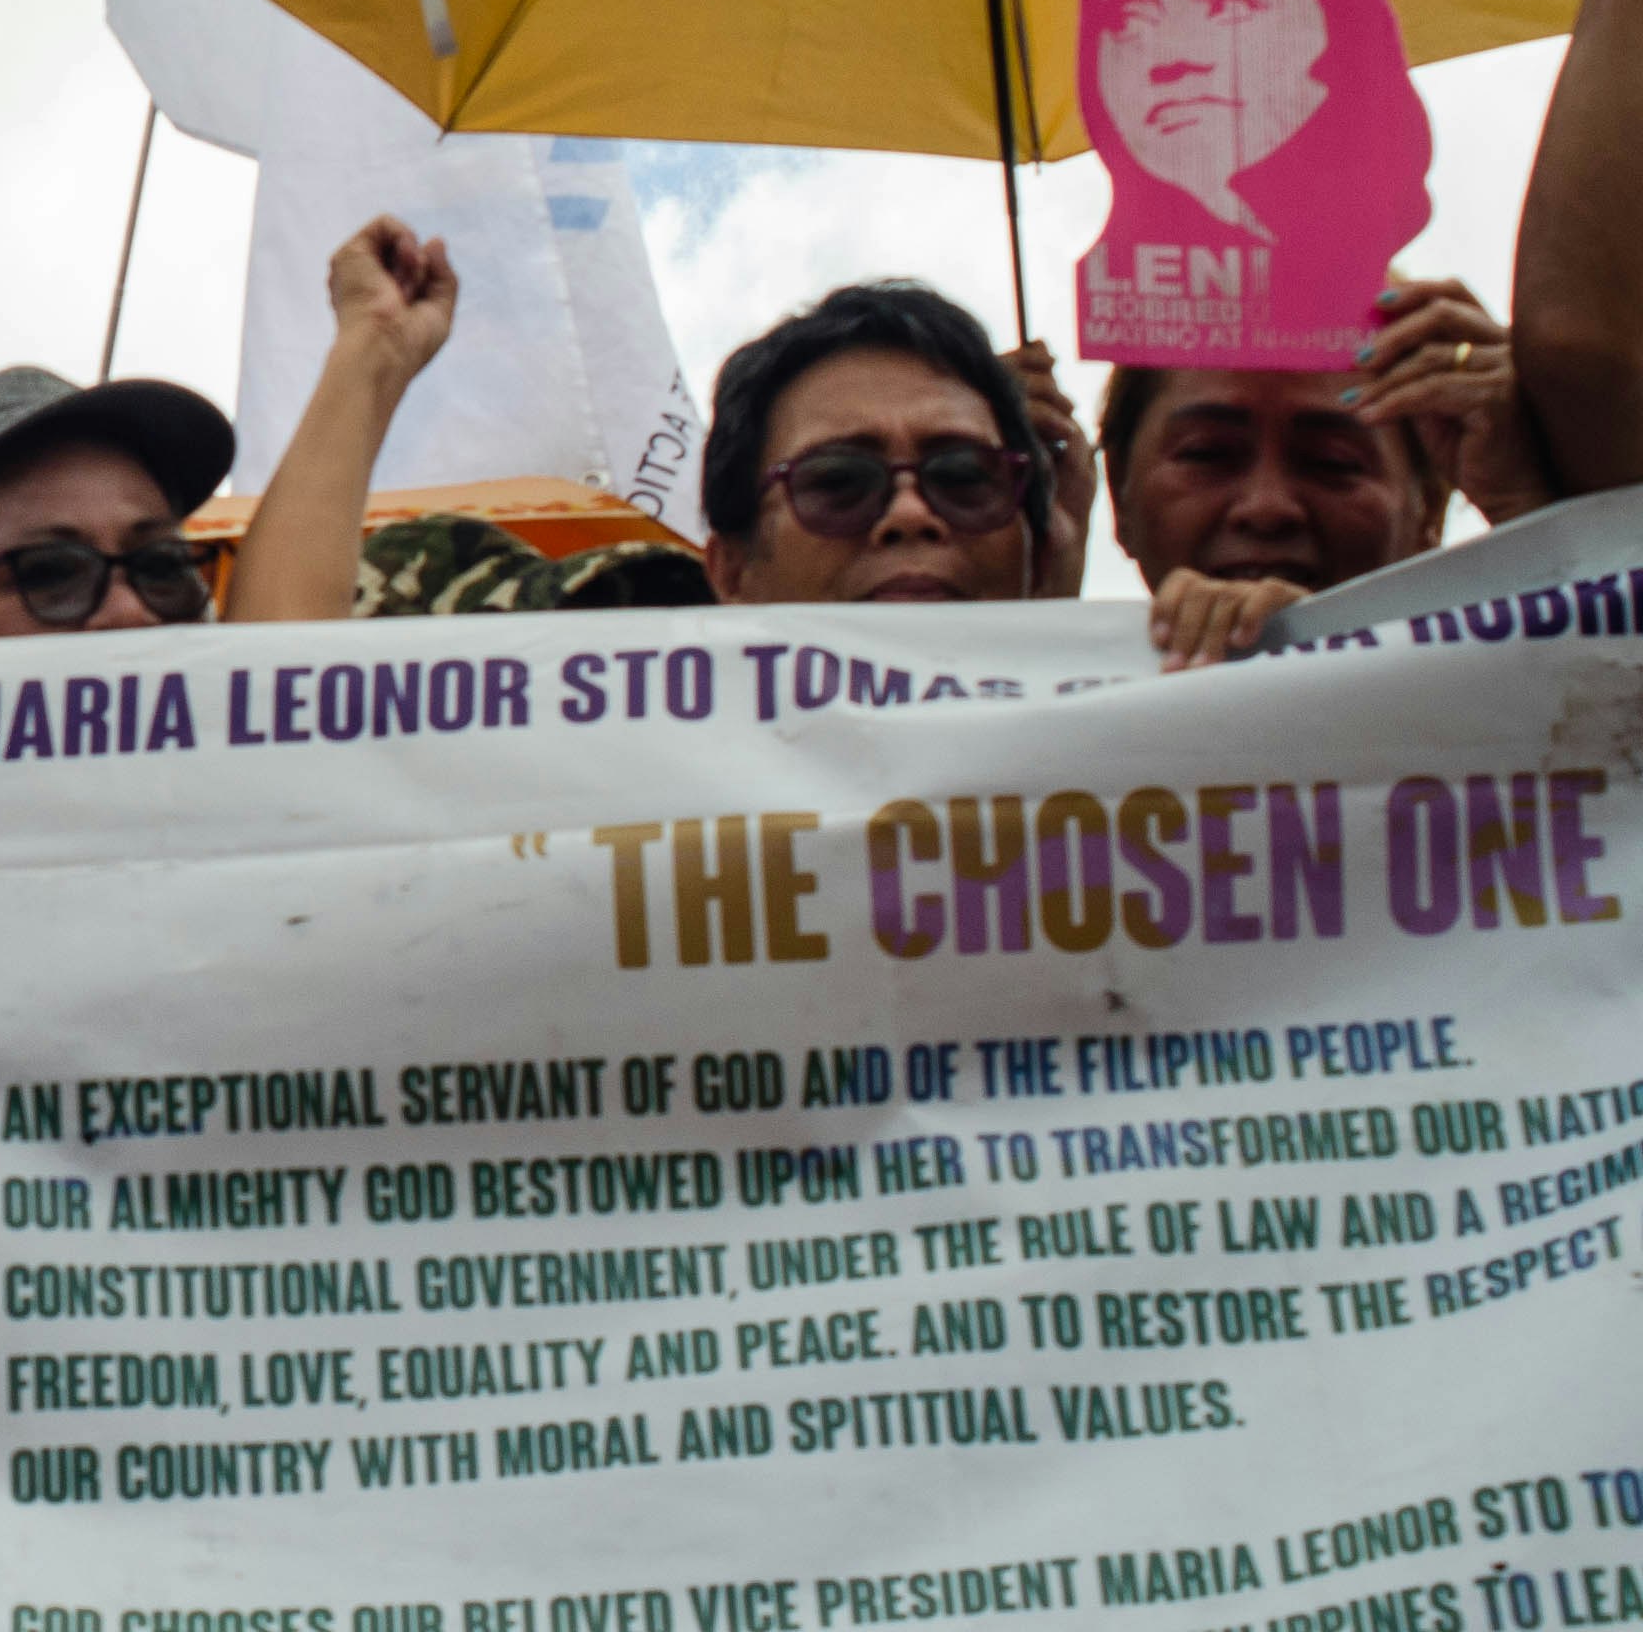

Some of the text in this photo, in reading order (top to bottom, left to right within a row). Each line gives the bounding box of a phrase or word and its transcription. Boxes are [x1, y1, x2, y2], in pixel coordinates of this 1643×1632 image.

[1085, 244, 1272, 296] LENI
[227, 657, 530, 746] LEONOR
[560, 646, 714, 724] STO
[593, 811, 830, 970] THE
[867, 781, 1345, 960] CHOSEN
[1386, 770, 1622, 938] ONE
[2, 1016, 1476, 1141] AN EXCEPTIONAL SERVANT OF GOD AND OF THE FILIPINO PEOPLE.
[3, 1177, 92, 1231] OUR
[109, 1168, 347, 1232] ALMIGHTY
[366, 1161, 455, 1223] GOD
[473, 1152, 722, 1219] BESTOWED
[737, 1145, 860, 1208] UPON
[874, 1135, 965, 1195] HER
[979, 1132, 1037, 1184] TO
[1051, 1106, 1397, 1178] TRANSFORMED
[1412, 1100, 1507, 1156] OUR
[4, 1145, 1643, 1321] CONSTITUTIONAL GOVERNMENT, UNDER THE RULE OF LAW AND A REGIM
[9, 1214, 1624, 1415] FREEDOM, LOVE, EQUALITY AND PEACE. AND TO RESTORE THE RESPECT
[11, 1379, 1247, 1505] OUR COUNTRY WITH MORAL AND SPITITUAL VALUES.
[687, 1578, 801, 1632] VICE
[813, 1558, 1078, 1632] PRESIDENT
[1096, 1542, 1263, 1607] MARIA
[1275, 1495, 1462, 1584] LEONOR
[1473, 1477, 1570, 1539] STO
[1579, 1469, 1643, 1528] TO
[1473, 1573, 1541, 1632] TO
